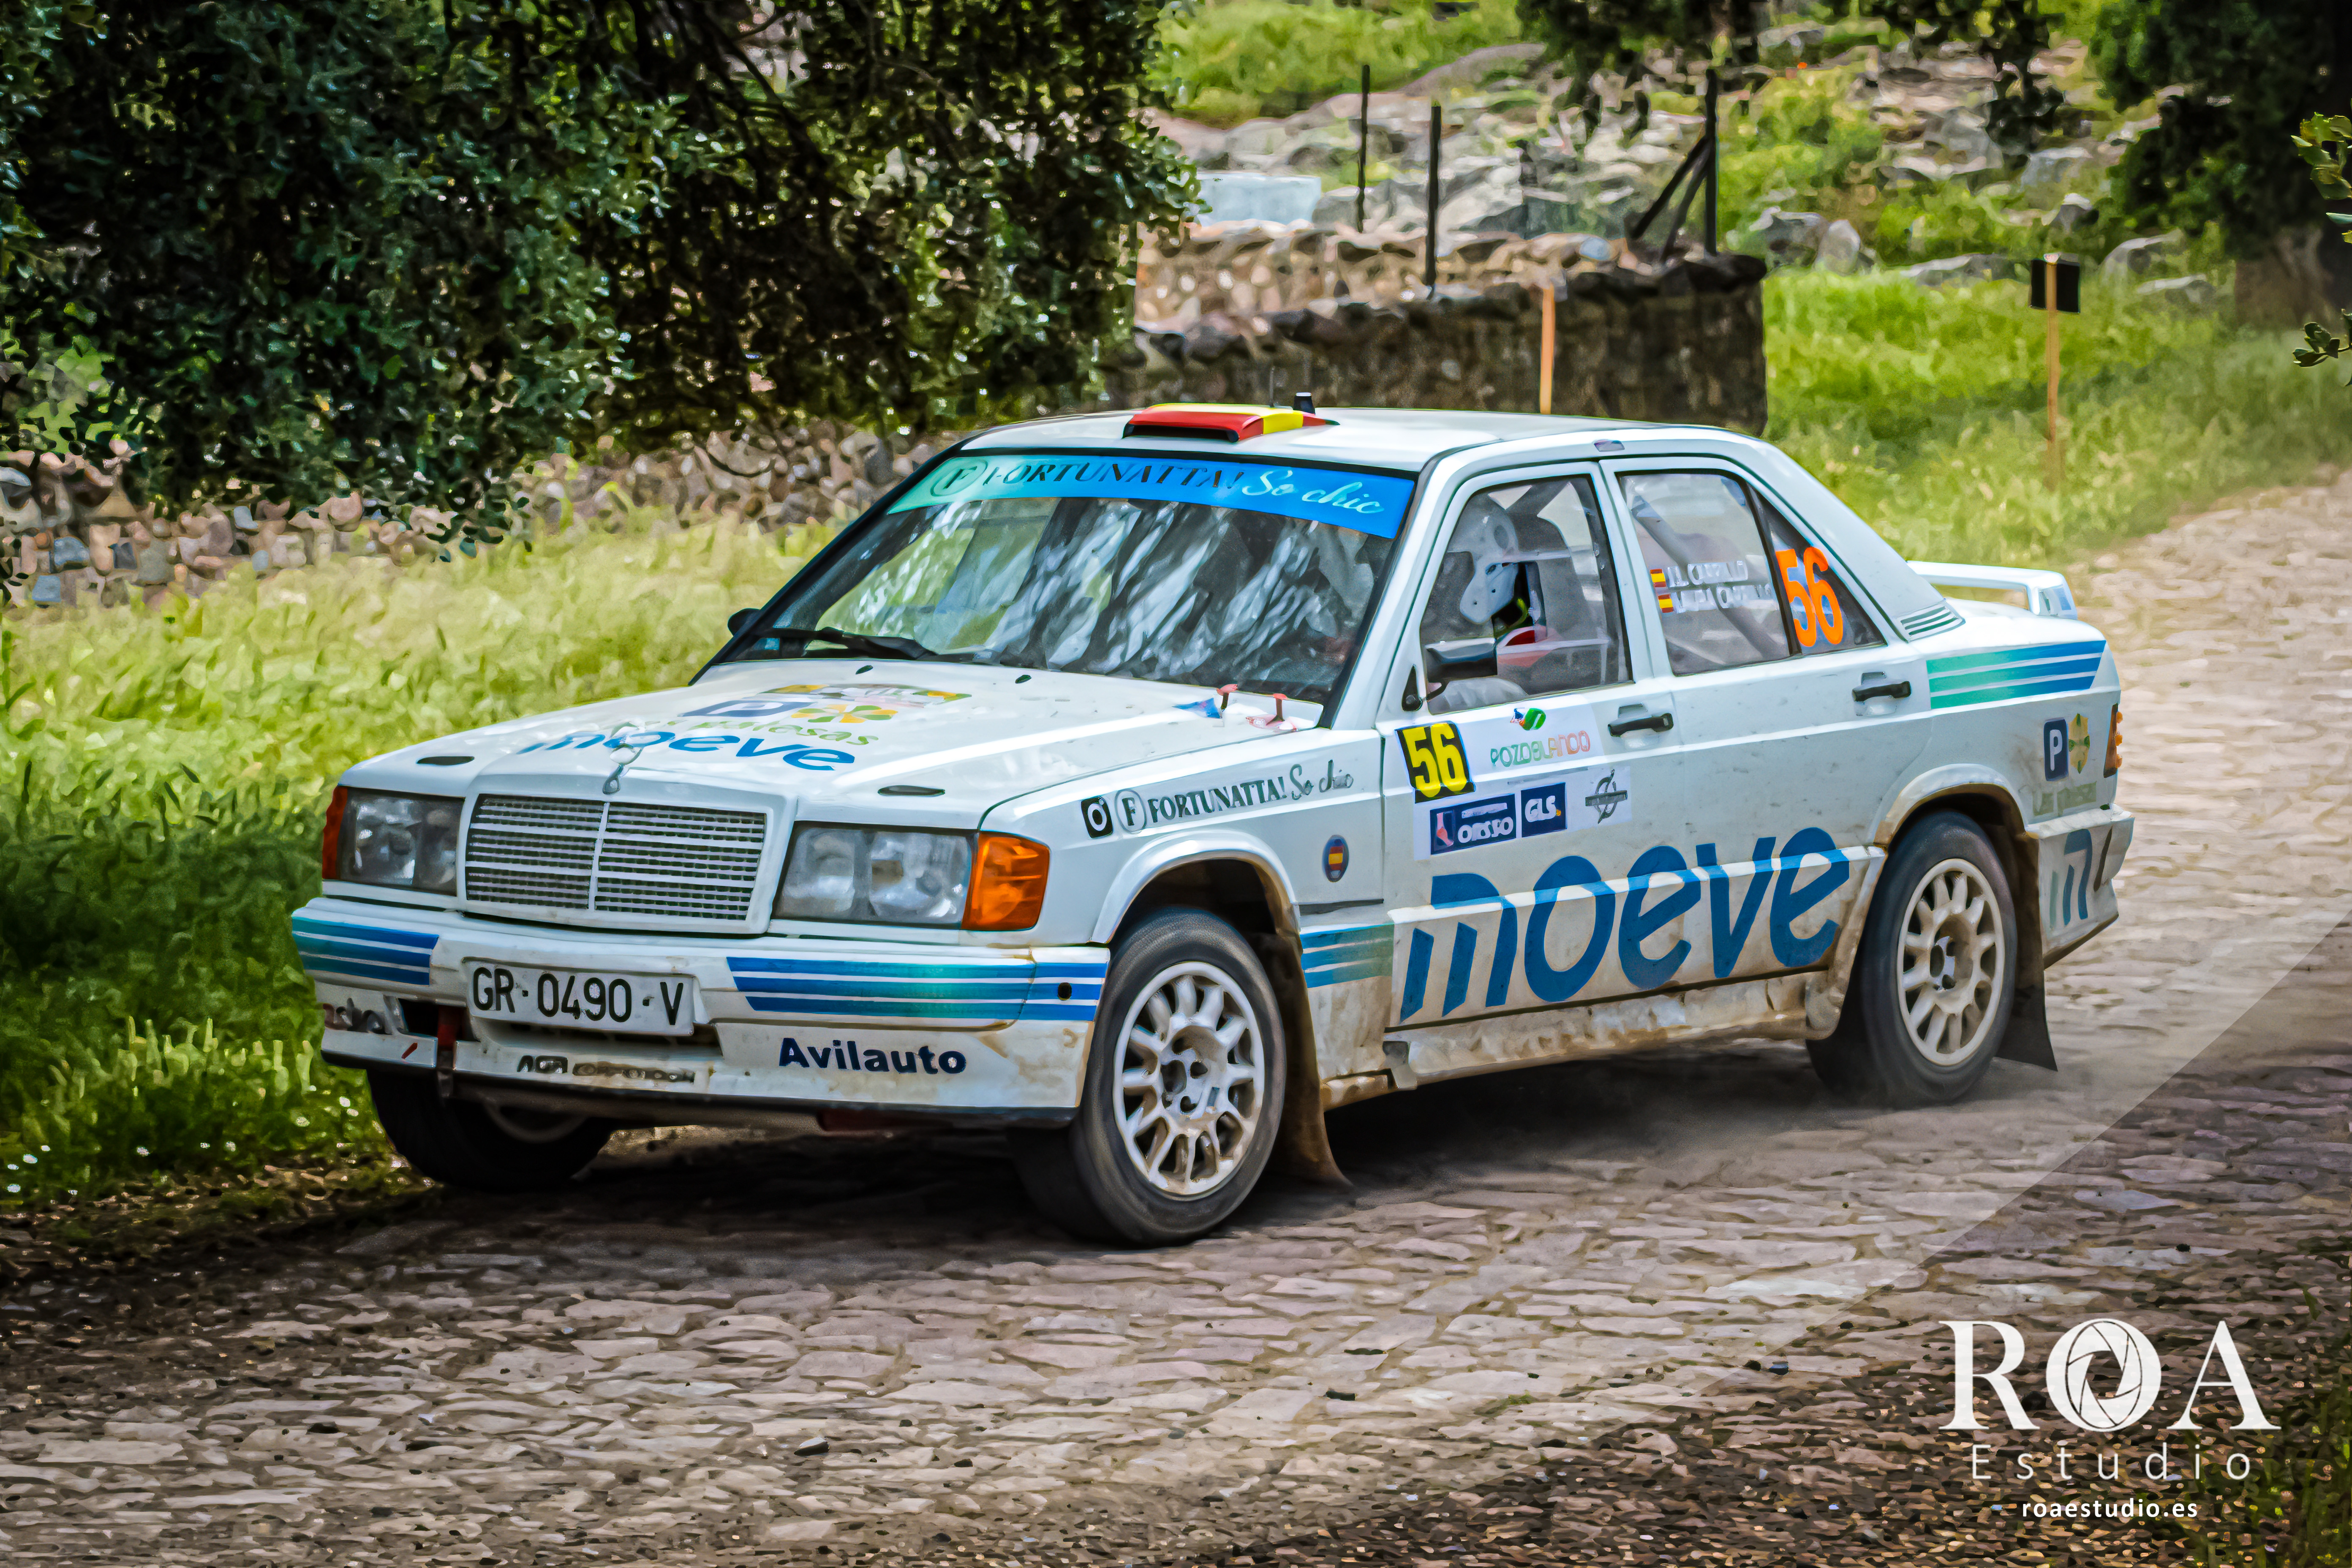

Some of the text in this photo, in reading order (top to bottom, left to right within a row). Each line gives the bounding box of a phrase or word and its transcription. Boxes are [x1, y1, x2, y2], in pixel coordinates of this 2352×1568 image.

[1242, 469, 1295, 496] So
[1301, 481, 1385, 514] chic
[1775, 547, 1843, 647] 56
[516, 730, 855, 771] moeve
[1402, 723, 1469, 798] 56
[1147, 776, 1287, 823] FORTUNATTA!
[1289, 764, 1314, 800] So
[1400, 827, 1850, 1024] moeve
[779, 1037, 967, 1075] Avilauto
